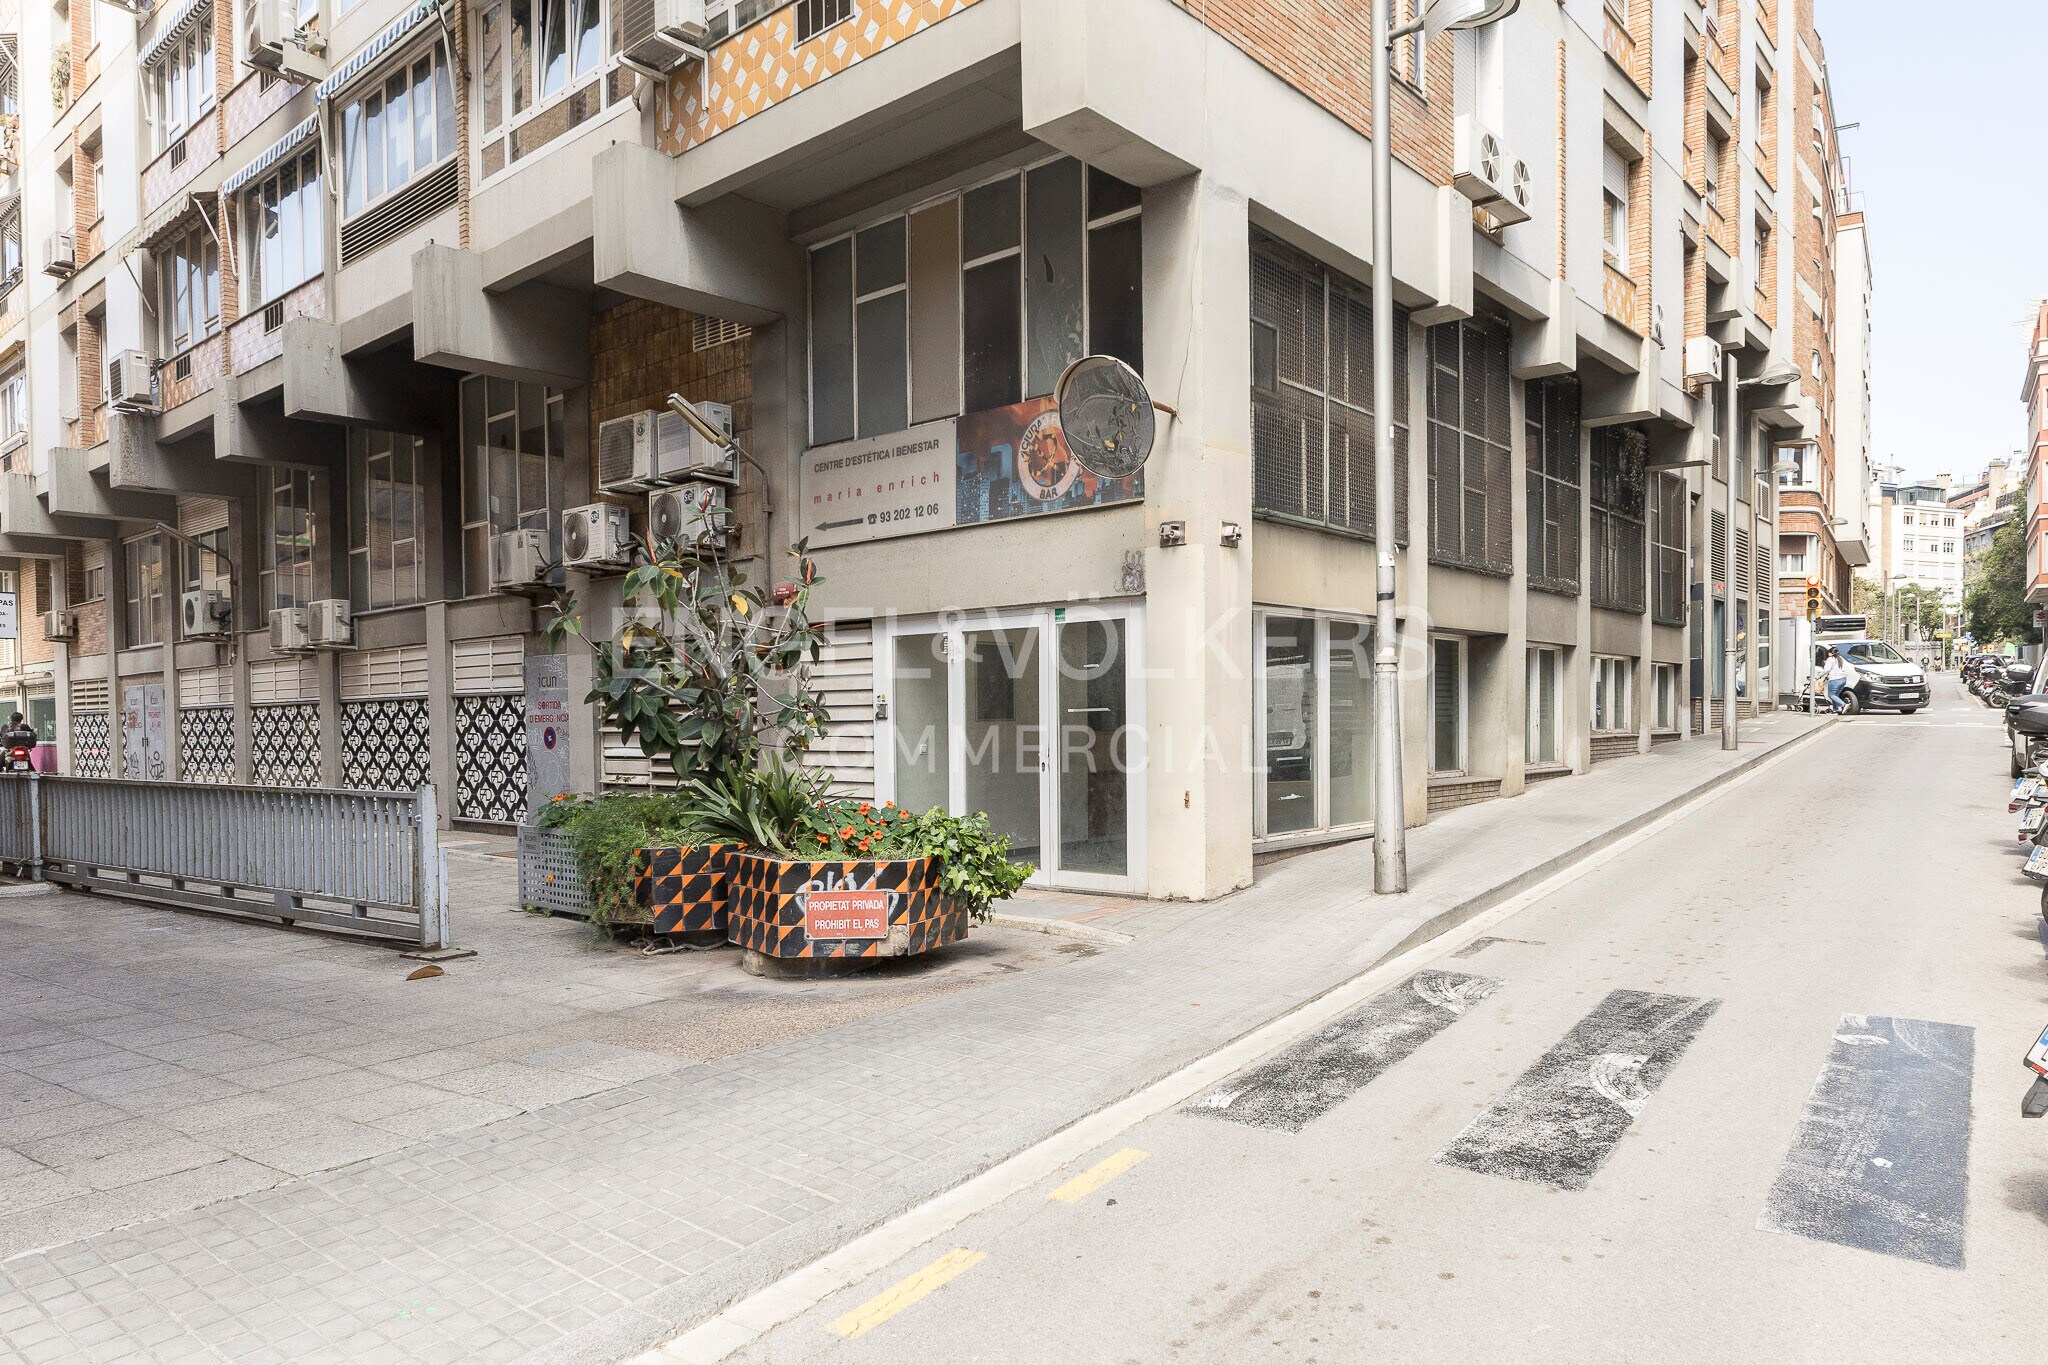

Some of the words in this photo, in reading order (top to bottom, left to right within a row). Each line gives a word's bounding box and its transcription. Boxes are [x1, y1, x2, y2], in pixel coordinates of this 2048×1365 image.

[814, 458, 844, 473] CENTRE
[845, 449, 890, 467] D'ESTÈTICA
[896, 438, 940, 456] BENESTAR
[813, 487, 862, 504] maria
[876, 471, 940, 493] enrich
[1040, 487, 1058, 500] BAR
[880, 511, 891, 523] 93
[893, 507, 911, 521] 202
[914, 504, 924, 518] 12
[926, 502, 939, 515] 06
[538, 673, 557, 688] icun
[537, 700, 562, 710] SORTIDA
[809, 899, 851, 912] PROPIETAT
[852, 899, 885, 911] PRIVADA
[814, 918, 852, 930] PROHIBIT
[852, 918, 862, 929] EL
[864, 918, 880, 929] PAS
